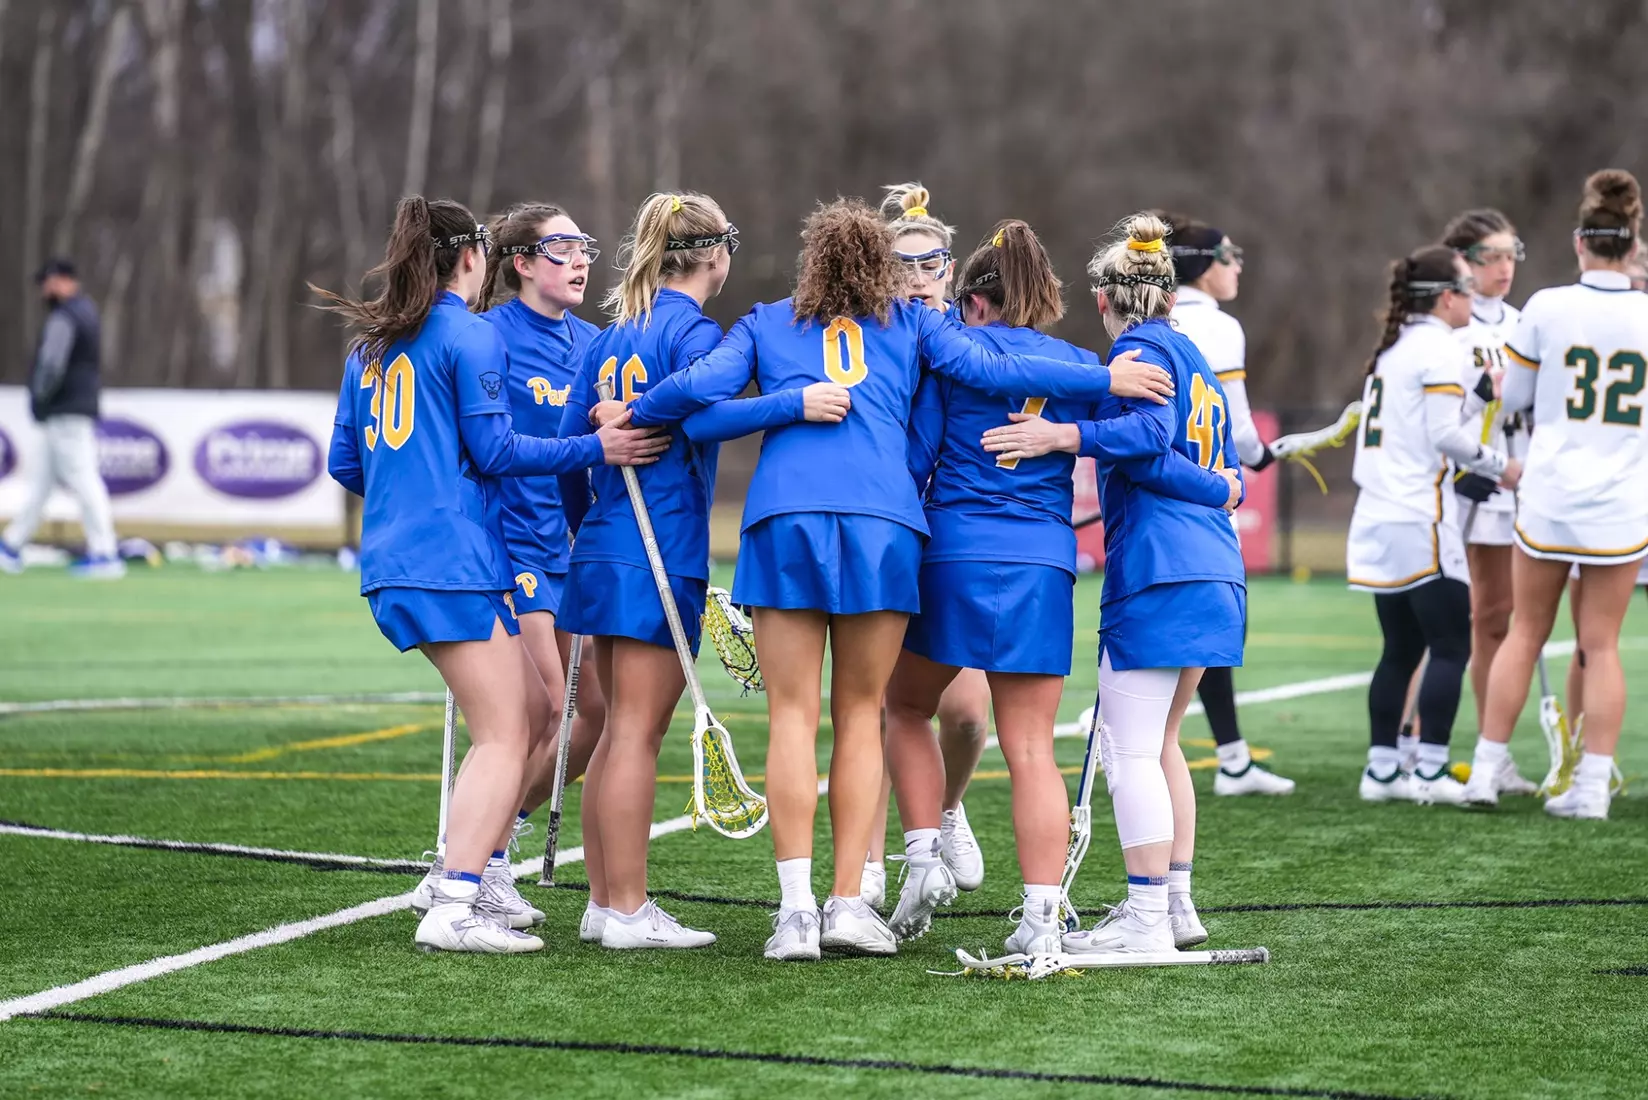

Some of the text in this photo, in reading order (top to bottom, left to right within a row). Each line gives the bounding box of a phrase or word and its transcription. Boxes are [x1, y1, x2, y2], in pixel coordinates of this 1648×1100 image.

[449, 233, 471, 245] STX
[511, 245, 530, 253] STX
[695, 237, 717, 247] STX
[976, 270, 999, 286] STX
[823, 316, 869, 389] 0
[1564, 344, 1647, 427] 32
[360, 352, 415, 452] 30
[515, 572, 538, 598] P
